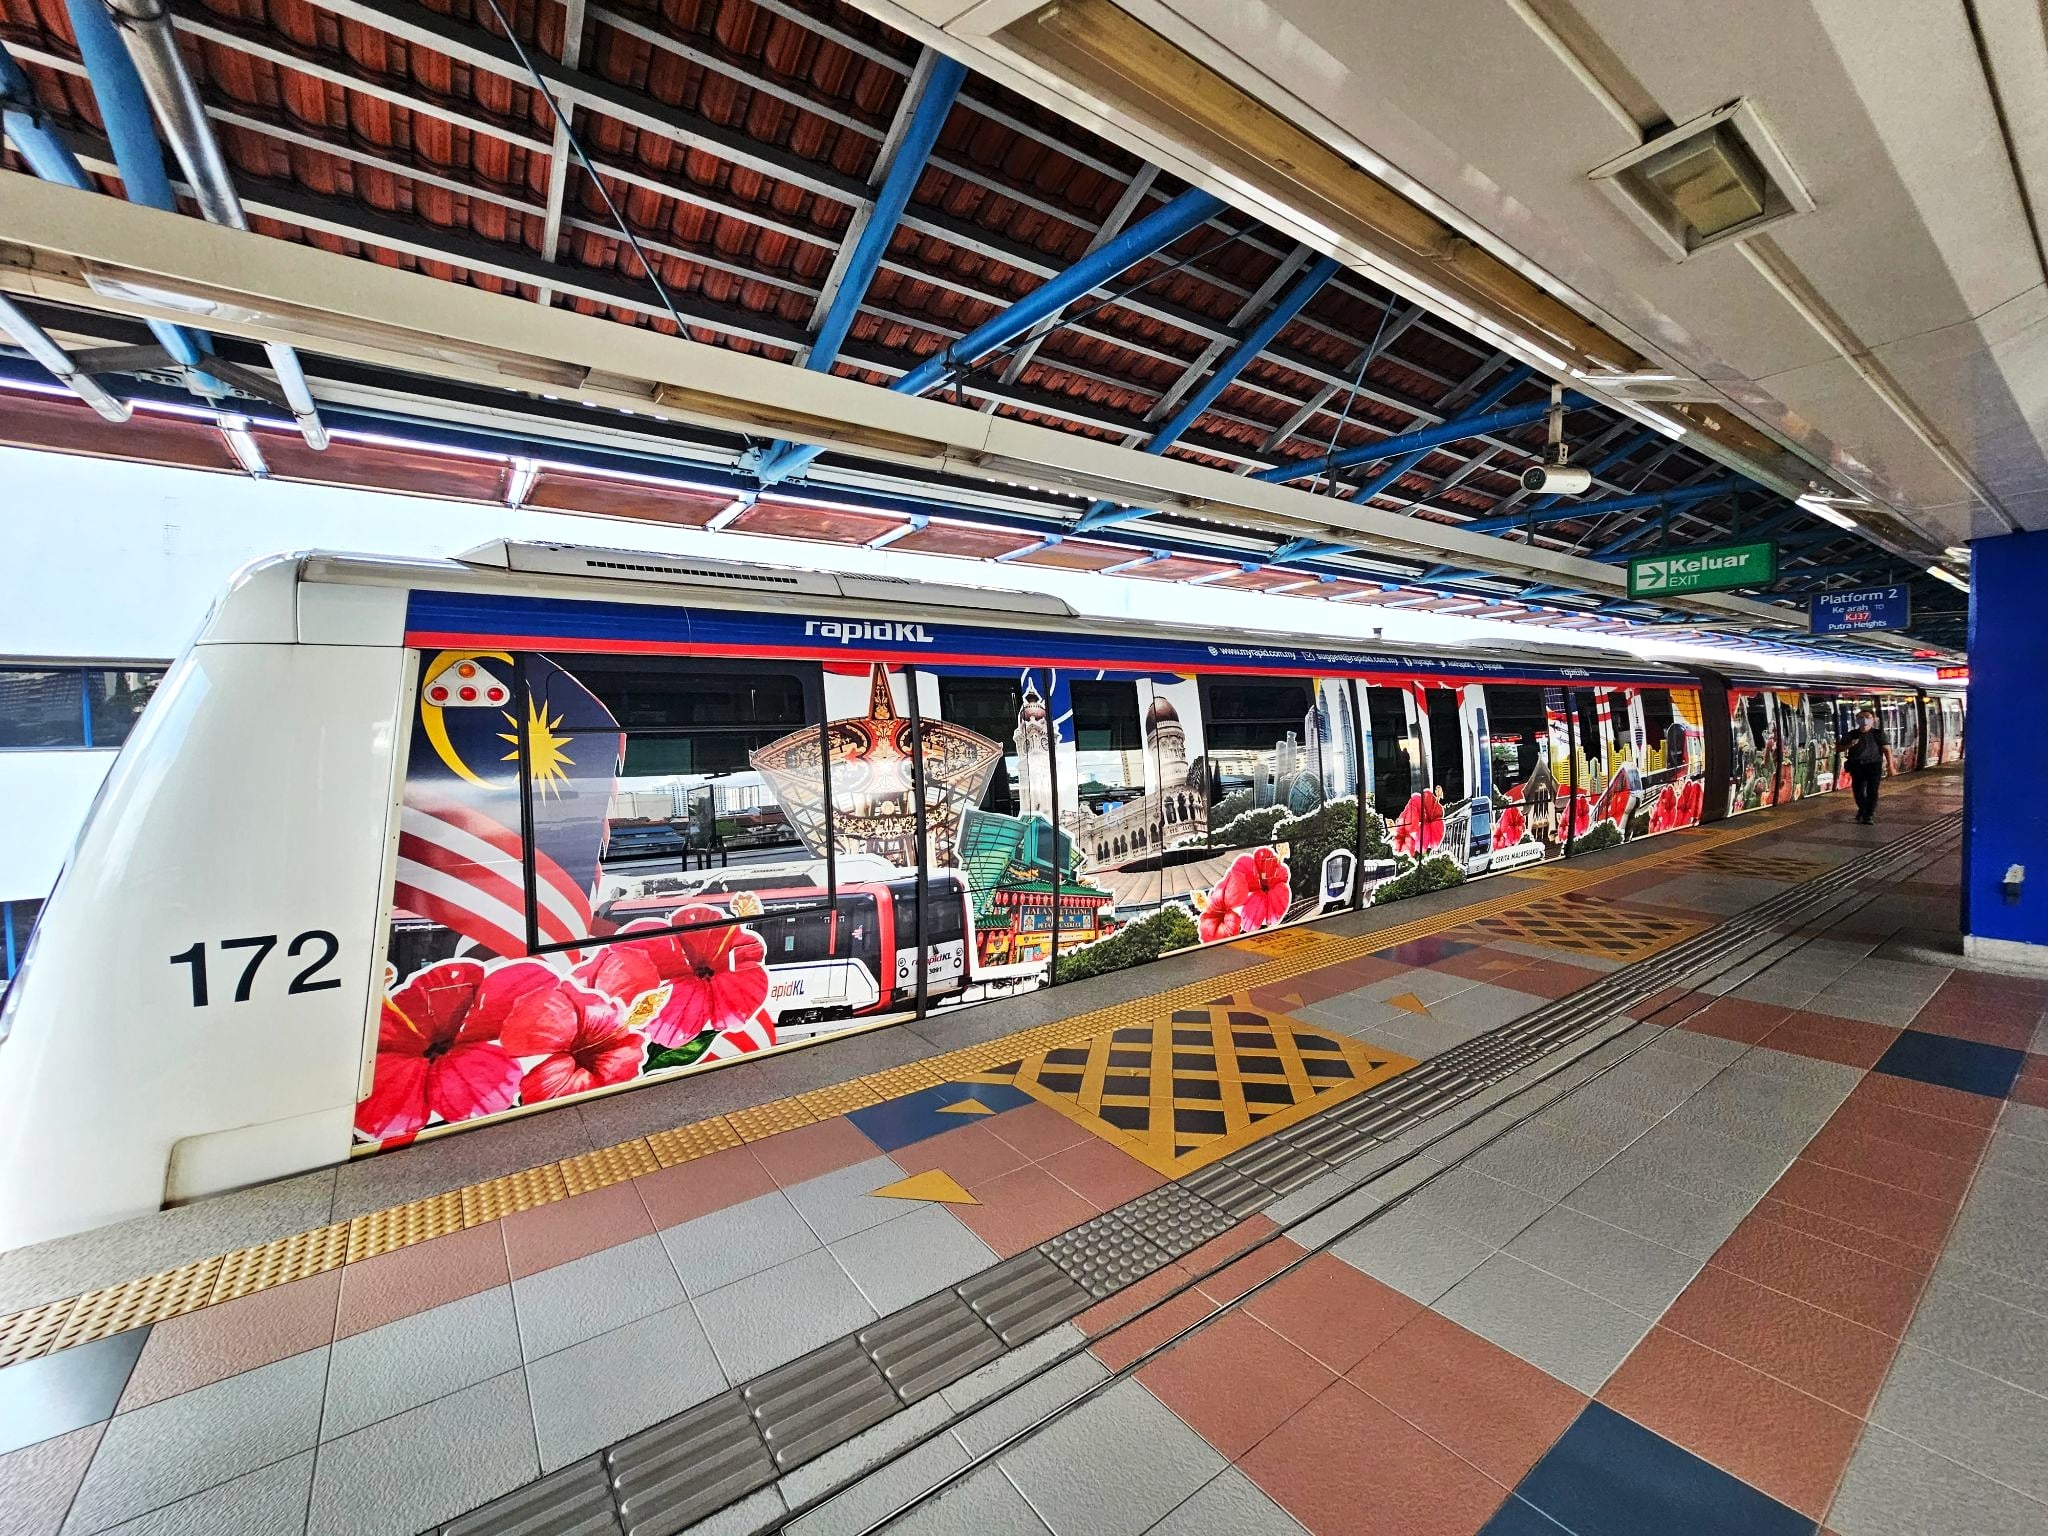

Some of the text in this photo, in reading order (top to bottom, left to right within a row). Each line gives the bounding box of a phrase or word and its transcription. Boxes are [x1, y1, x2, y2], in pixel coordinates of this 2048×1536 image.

[1669, 554, 1749, 574] Keluar
[1669, 575, 1700, 587] EXIT
[1820, 588, 1899, 605] Platform 2
[1832, 606, 1845, 614] Ke
[1847, 604, 1869, 612] arah
[1845, 612, 1870, 621] KJ37
[1853, 620, 1887, 629] Heights
[805, 620, 935, 644] rapidKL
[1219, 648, 1297, 660] www.myrapid.com.my
[1495, 855, 1510, 863] CERITA
[1059, 908, 1090, 916] ETALING
[170, 930, 341, 1008] 172
[771, 979, 805, 1001] apidKL
